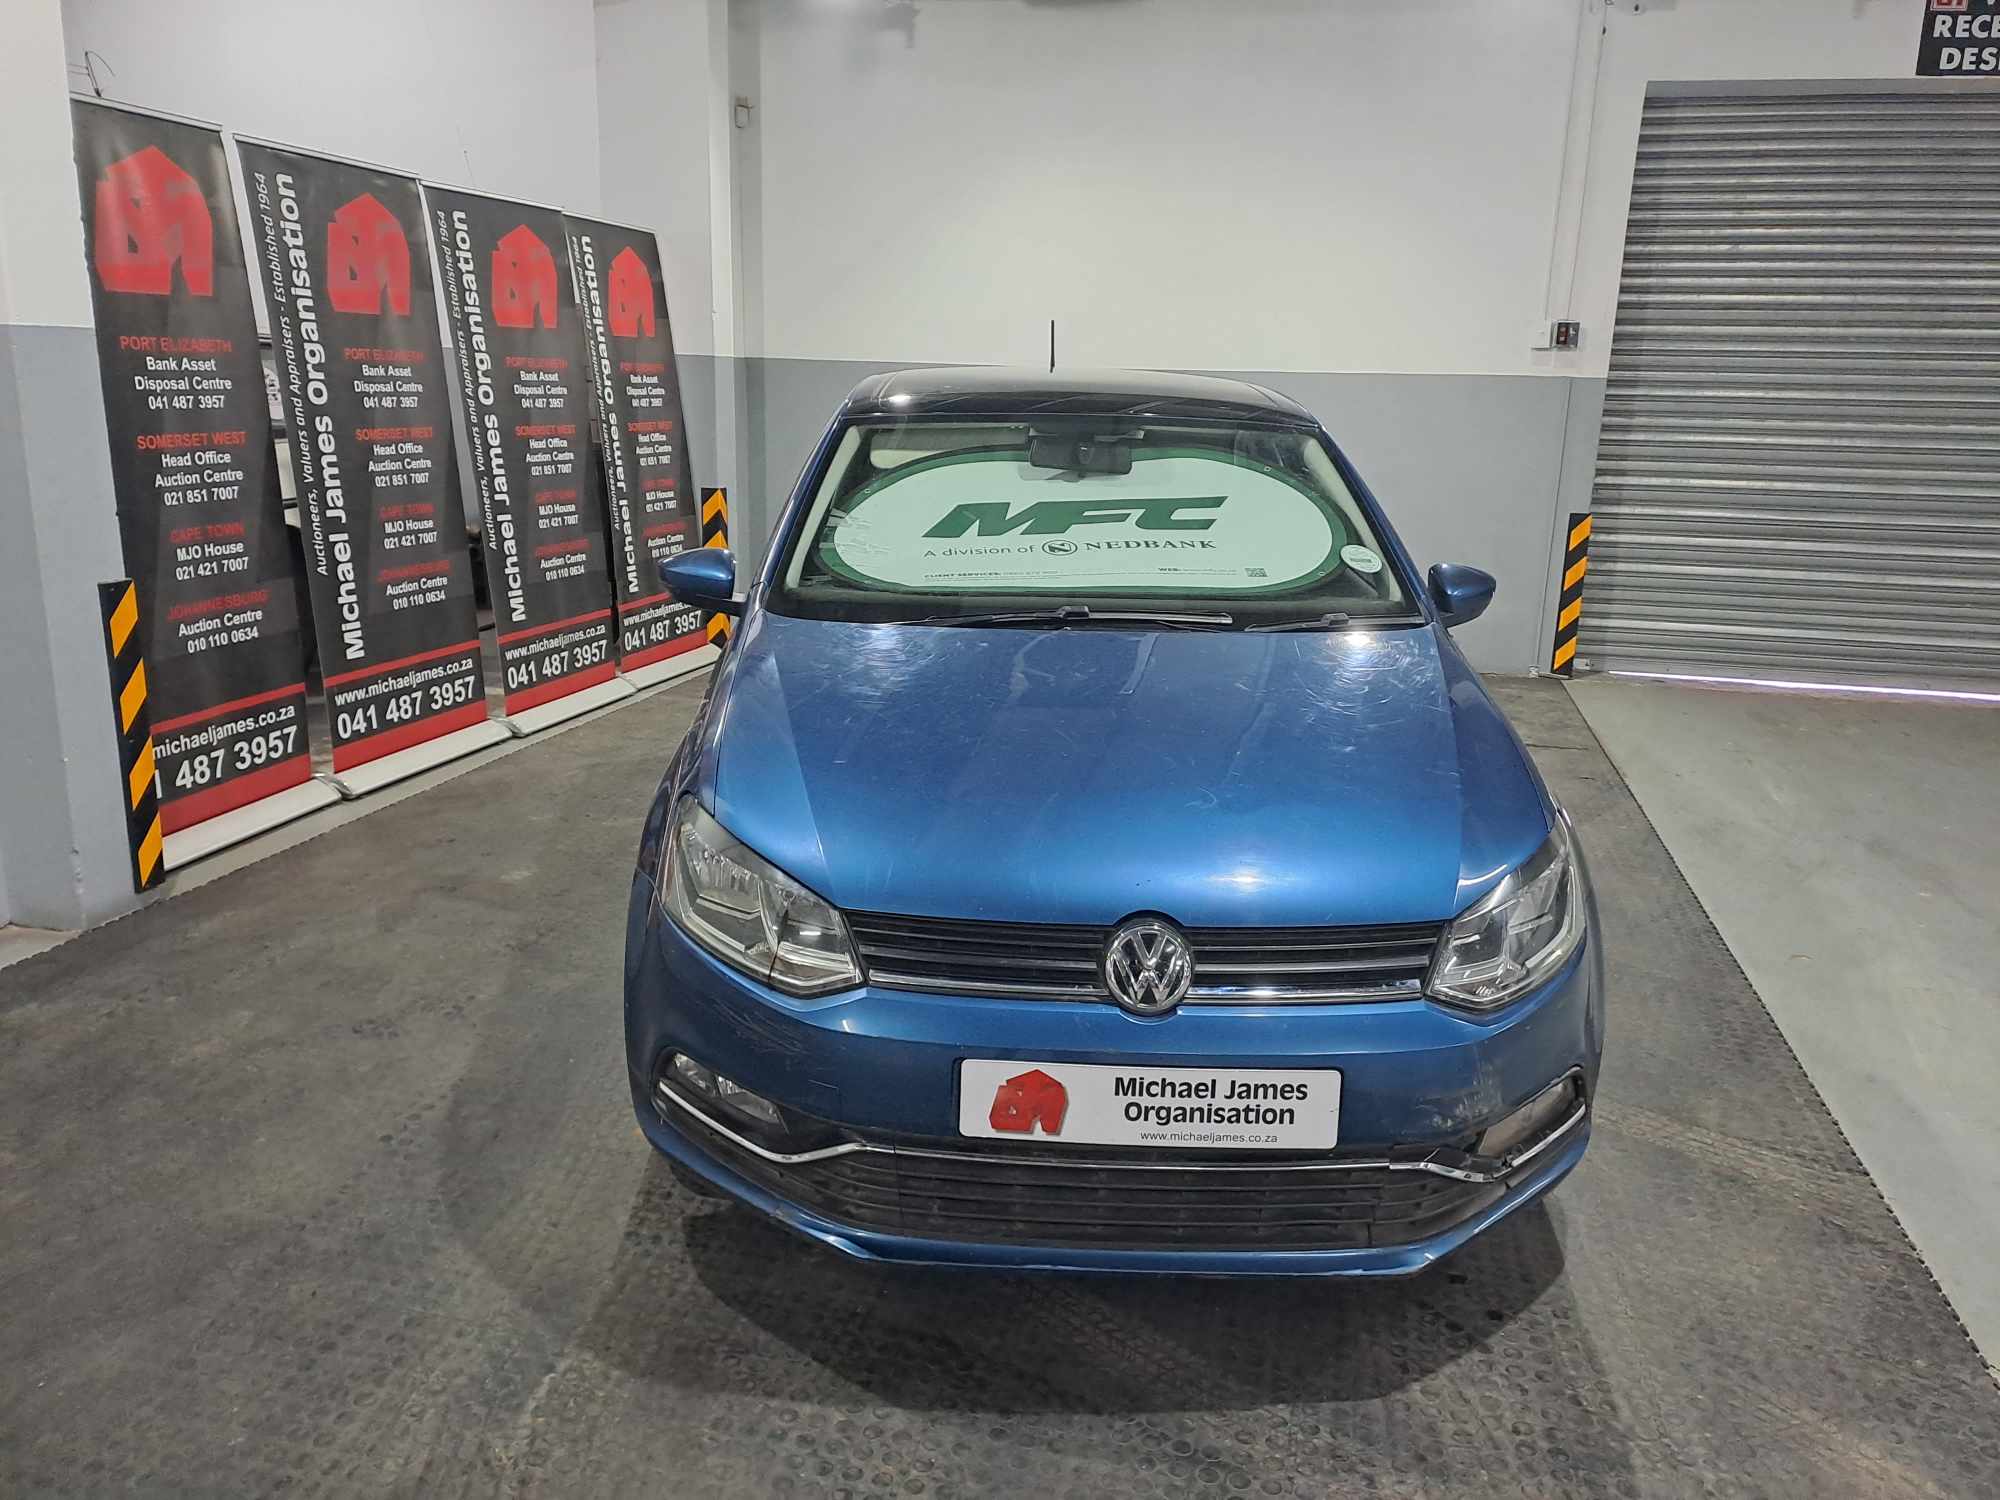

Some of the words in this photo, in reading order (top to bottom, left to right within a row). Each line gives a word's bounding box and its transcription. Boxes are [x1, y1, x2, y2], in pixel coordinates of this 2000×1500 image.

[1939, 47, 2000, 71] DES
[254, 172, 271, 211] 1964
[436, 210, 448, 242] 1964
[261, 214, 286, 302] Established
[275, 173, 328, 406] Organisation
[444, 244, 463, 319] Established
[452, 210, 494, 406] Organisation
[581, 235, 614, 406] Organisation
[120, 336, 155, 351] PORT
[280, 314, 301, 394] Appraisers
[146, 356, 178, 371] Bank
[180, 358, 216, 371] Asset
[362, 365, 386, 377] Bank
[388, 366, 412, 377] Asset
[458, 330, 474, 396] Appraisers
[134, 376, 189, 392] Disposal
[192, 377, 232, 390] Centre
[354, 381, 394, 394] Disposal
[396, 381, 423, 393] Centre
[520, 371, 538, 382] Bank
[539, 372, 559, 382] Asset
[148, 396, 169, 410] 041
[172, 396, 194, 409] 487
[197, 395, 225, 409] 3957
[363, 397, 379, 409] 041
[380, 396, 397, 408] 487
[399, 396, 419, 408] 3957
[514, 384, 544, 396] Disposal
[546, 384, 568, 395] Centre
[294, 397, 306, 426] and
[466, 398, 478, 423] and
[136, 432, 209, 449] SOMERSET
[211, 431, 247, 446] WEST
[373, 444, 396, 455] Head
[398, 443, 423, 454] Office
[471, 425, 484, 472] Valuers
[530, 438, 547, 449] Head
[548, 438, 568, 448] Office
[608, 412, 627, 493] James
[161, 453, 192, 468] Head
[195, 451, 231, 466] Office
[298, 430, 316, 483] Valuers
[368, 460, 402, 472] Auction
[404, 459, 432, 470] Centre
[484, 414, 510, 506] James
[526, 452, 552, 464] Auction
[155, 472, 200, 488] Auction
[203, 469, 244, 483] Centre
[315, 415, 346, 524] James
[375, 476, 390, 487] 021
[392, 475, 409, 486] 851
[410, 472, 430, 485] 7007
[164, 492, 184, 506] 021
[186, 490, 208, 504] 851
[212, 486, 239, 501] 7007
[554, 503, 576, 514] House
[480, 476, 498, 550] Auctioneers,
[921, 495, 1229, 538] MFC
[308, 487, 328, 576] Auctioneers,
[384, 522, 404, 534] MJO
[406, 519, 433, 531] House
[176, 546, 202, 562] MJO
[204, 542, 244, 558] House
[384, 538, 400, 550] 021
[400, 536, 418, 547] 421
[418, 532, 438, 545] 7007
[618, 499, 640, 594] Michael
[923, 550, 936, 558] A
[942, 546, 1012, 556] division
[1016, 544, 1034, 554] of
[1084, 540, 1217, 551] NEDBANK
[176, 565, 195, 581] 021
[197, 562, 220, 577] 421
[221, 557, 249, 573] 7007
[497, 514, 528, 622] Michael
[540, 557, 565, 568] Auction
[329, 532, 365, 661] Michael
[386, 582, 420, 596] Auction
[420, 576, 448, 590] Centre
[393, 598, 408, 610] 010
[408, 596, 424, 607] 110
[425, 591, 446, 604] 0634
[178, 618, 222, 638] Auction
[224, 608, 263, 628] Centre
[624, 628, 647, 651] 041
[650, 620, 670, 642] 487
[674, 610, 702, 634] 3957
[188, 639, 207, 654] 010
[208, 634, 229, 648] 110
[231, 626, 259, 643] 0634
[504, 623, 606, 662] www.michaeljames.co.za
[507, 660, 537, 689] 041
[542, 649, 568, 678] 487
[572, 639, 608, 669] 3957
[334, 656, 474, 706] www.michaeljames.co.za
[337, 707, 379, 740] 041
[385, 692, 422, 723] 487
[430, 675, 476, 711] 3957
[175, 753, 225, 790] 487
[233, 725, 298, 771] 3957
[1114, 1076, 1217, 1100] Michael
[1224, 1078, 1308, 1101] James
[1124, 1102, 1296, 1127] Organisation
[1140, 1130, 1279, 1144] www.michaeljames.co.za
